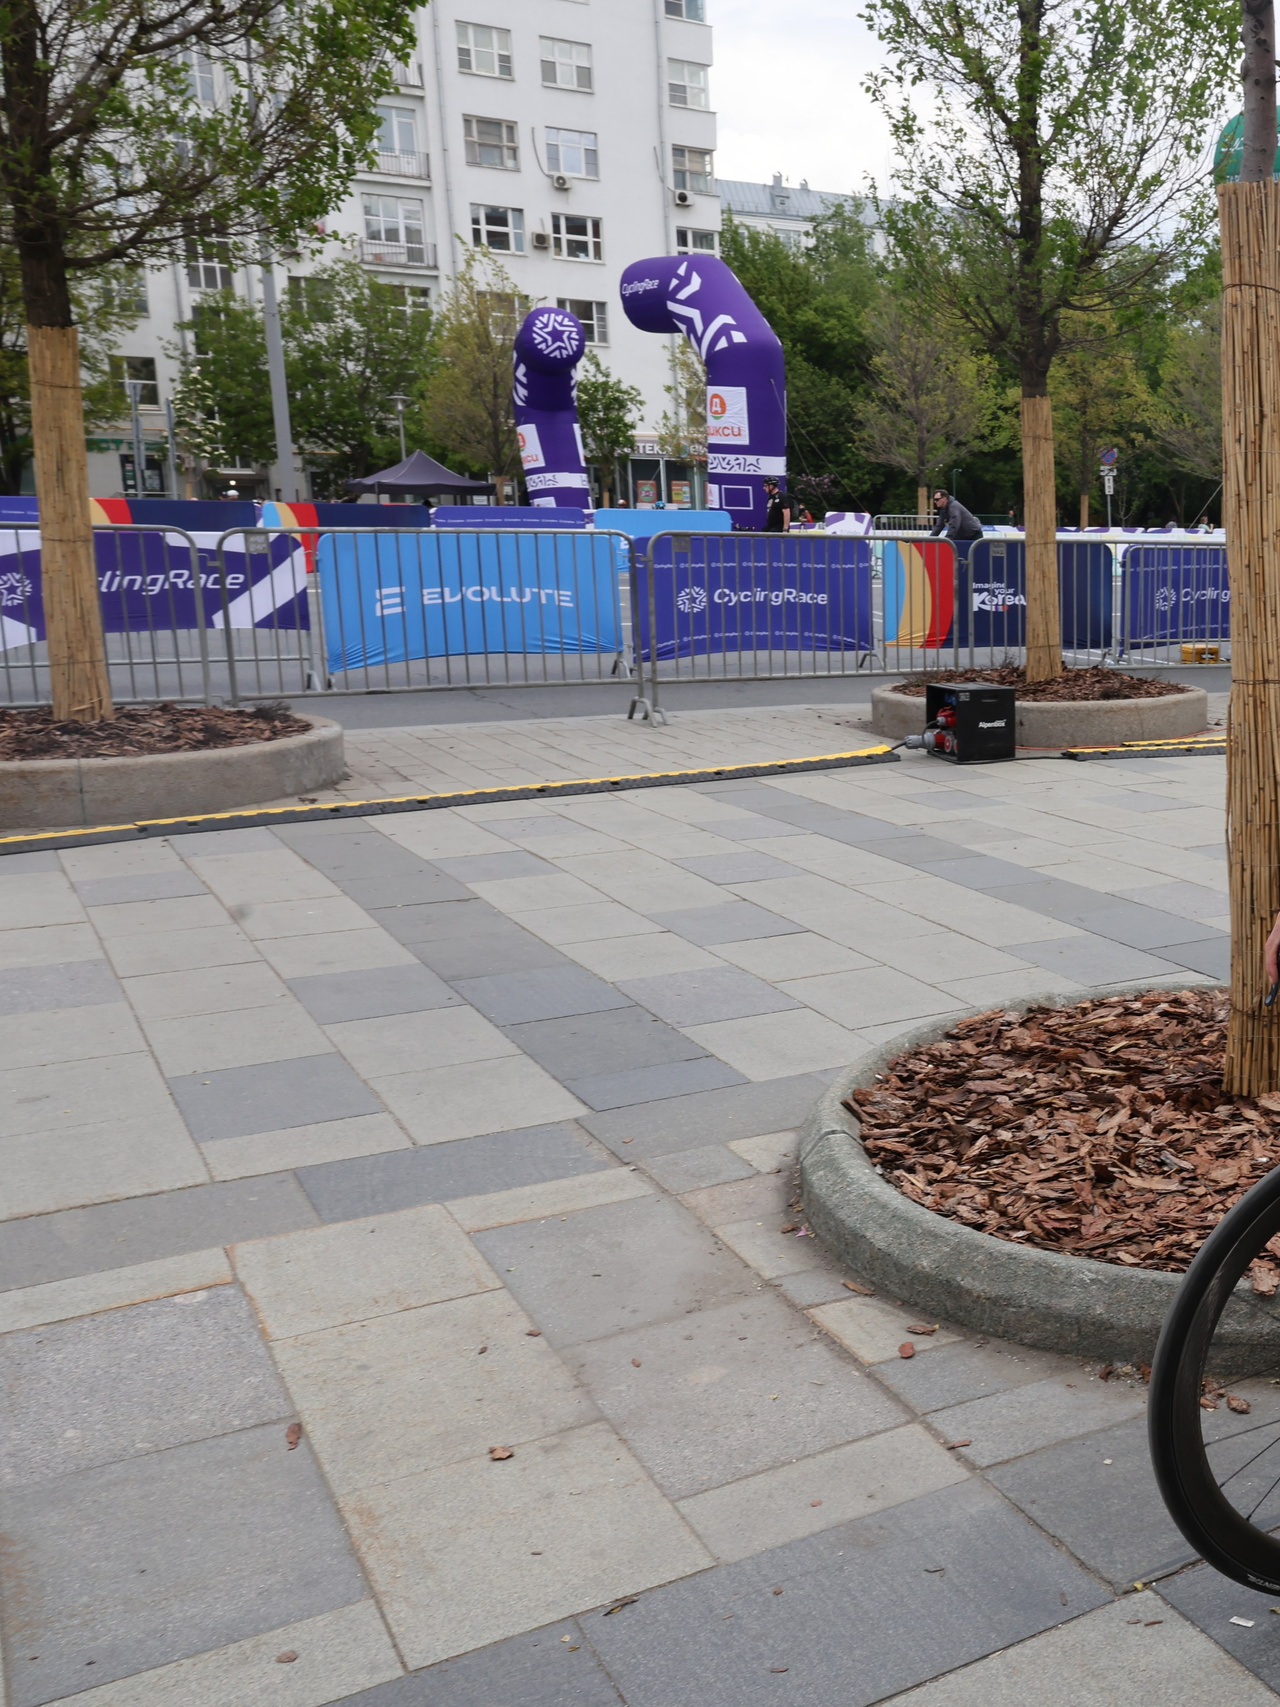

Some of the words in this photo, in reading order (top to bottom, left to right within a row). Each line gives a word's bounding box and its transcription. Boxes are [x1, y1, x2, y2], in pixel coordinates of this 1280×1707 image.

[97, 569, 245, 595] lingRace
[422, 585, 574, 607] EVOLUTE
[713, 587, 828, 606] CyclingRace
[972, 591, 1027, 612] Korea
